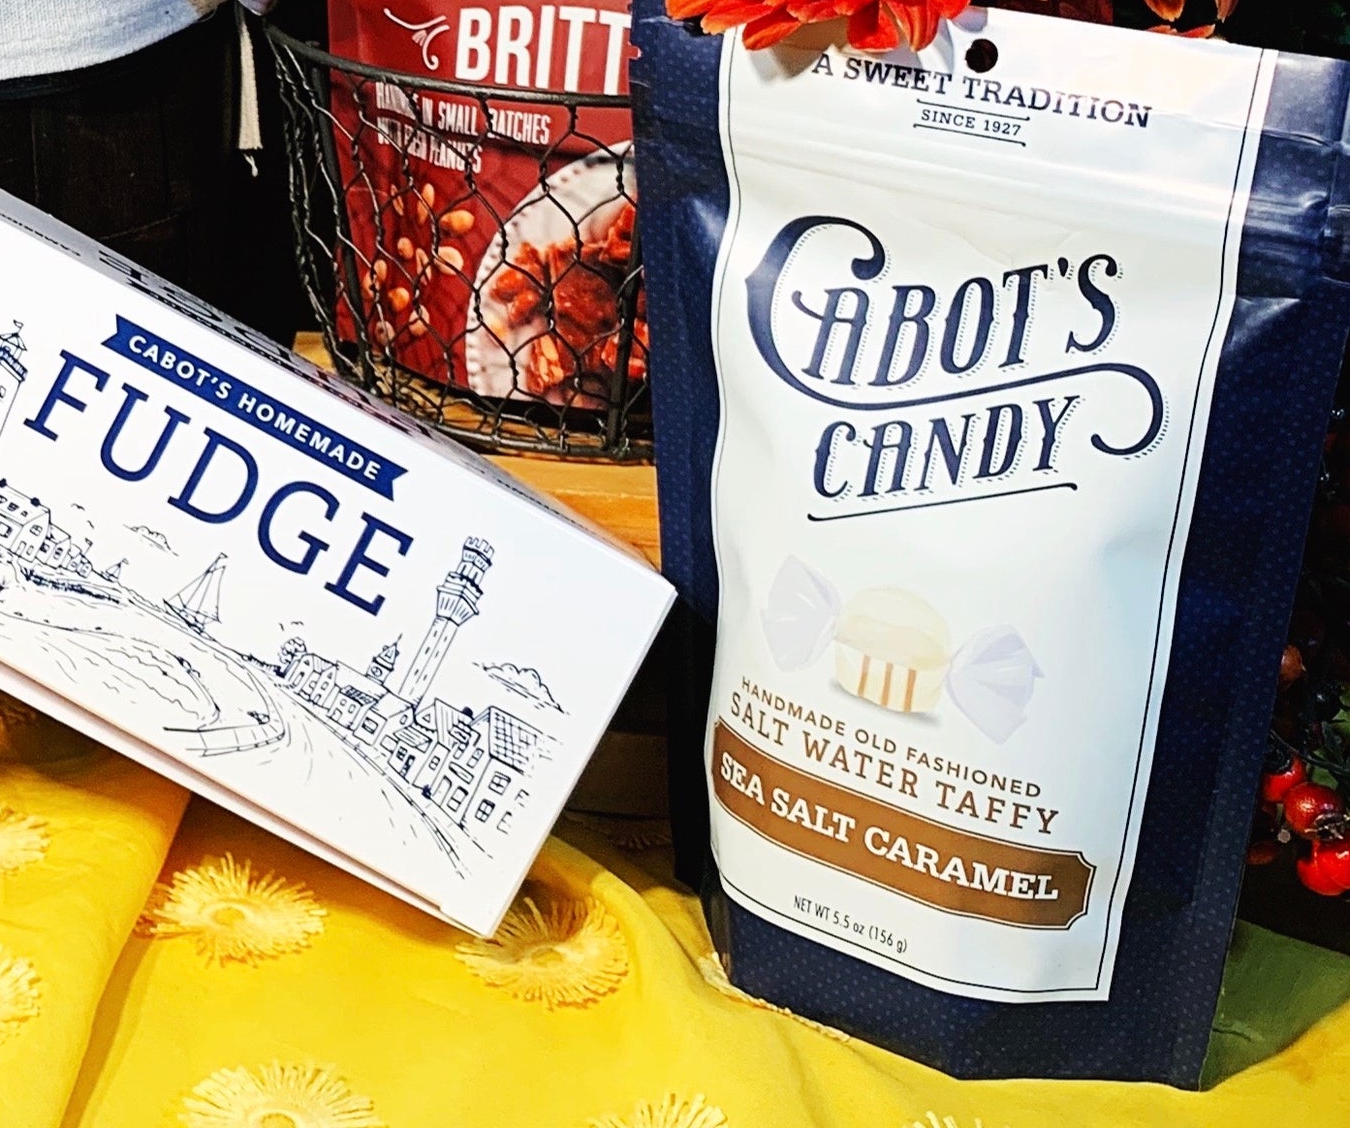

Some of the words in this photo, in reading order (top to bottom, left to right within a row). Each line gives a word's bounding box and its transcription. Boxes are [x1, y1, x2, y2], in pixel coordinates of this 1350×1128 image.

[455, 4, 633, 96] BRITT
[812, 53, 834, 77] A
[843, 57, 953, 96] SWEET
[962, 76, 1153, 129] TRADITION
[438, 100, 479, 137] SMALL
[921, 108, 976, 130] SINCE
[983, 120, 1022, 138] 1927
[744, 215, 1123, 412] CABOT'S
[129, 334, 232, 400] CABOT'S
[238, 394, 382, 482] HOMEMADE
[812, 394, 1084, 502] CANDY
[23, 348, 415, 618] FUDGE
[730, 690, 790, 747] SALT
[802, 730, 920, 799] WATER
[935, 780, 1060, 835] TAFFY
[741, 676, 846, 737] HANDMADE
[854, 727, 898, 756] OLD
[906, 747, 1042, 799] FASHIONED
[720, 750, 765, 806] SEA
[770, 786, 857, 843] SALT
[863, 825, 1059, 901] CARAMEL
[793, 894, 813, 913] NET
[815, 902, 831, 921] WT
[832, 910, 851, 929] 5.5
[852, 921, 866, 935] oz
[868, 924, 895, 947] (156
[896, 937, 908, 954] g)
